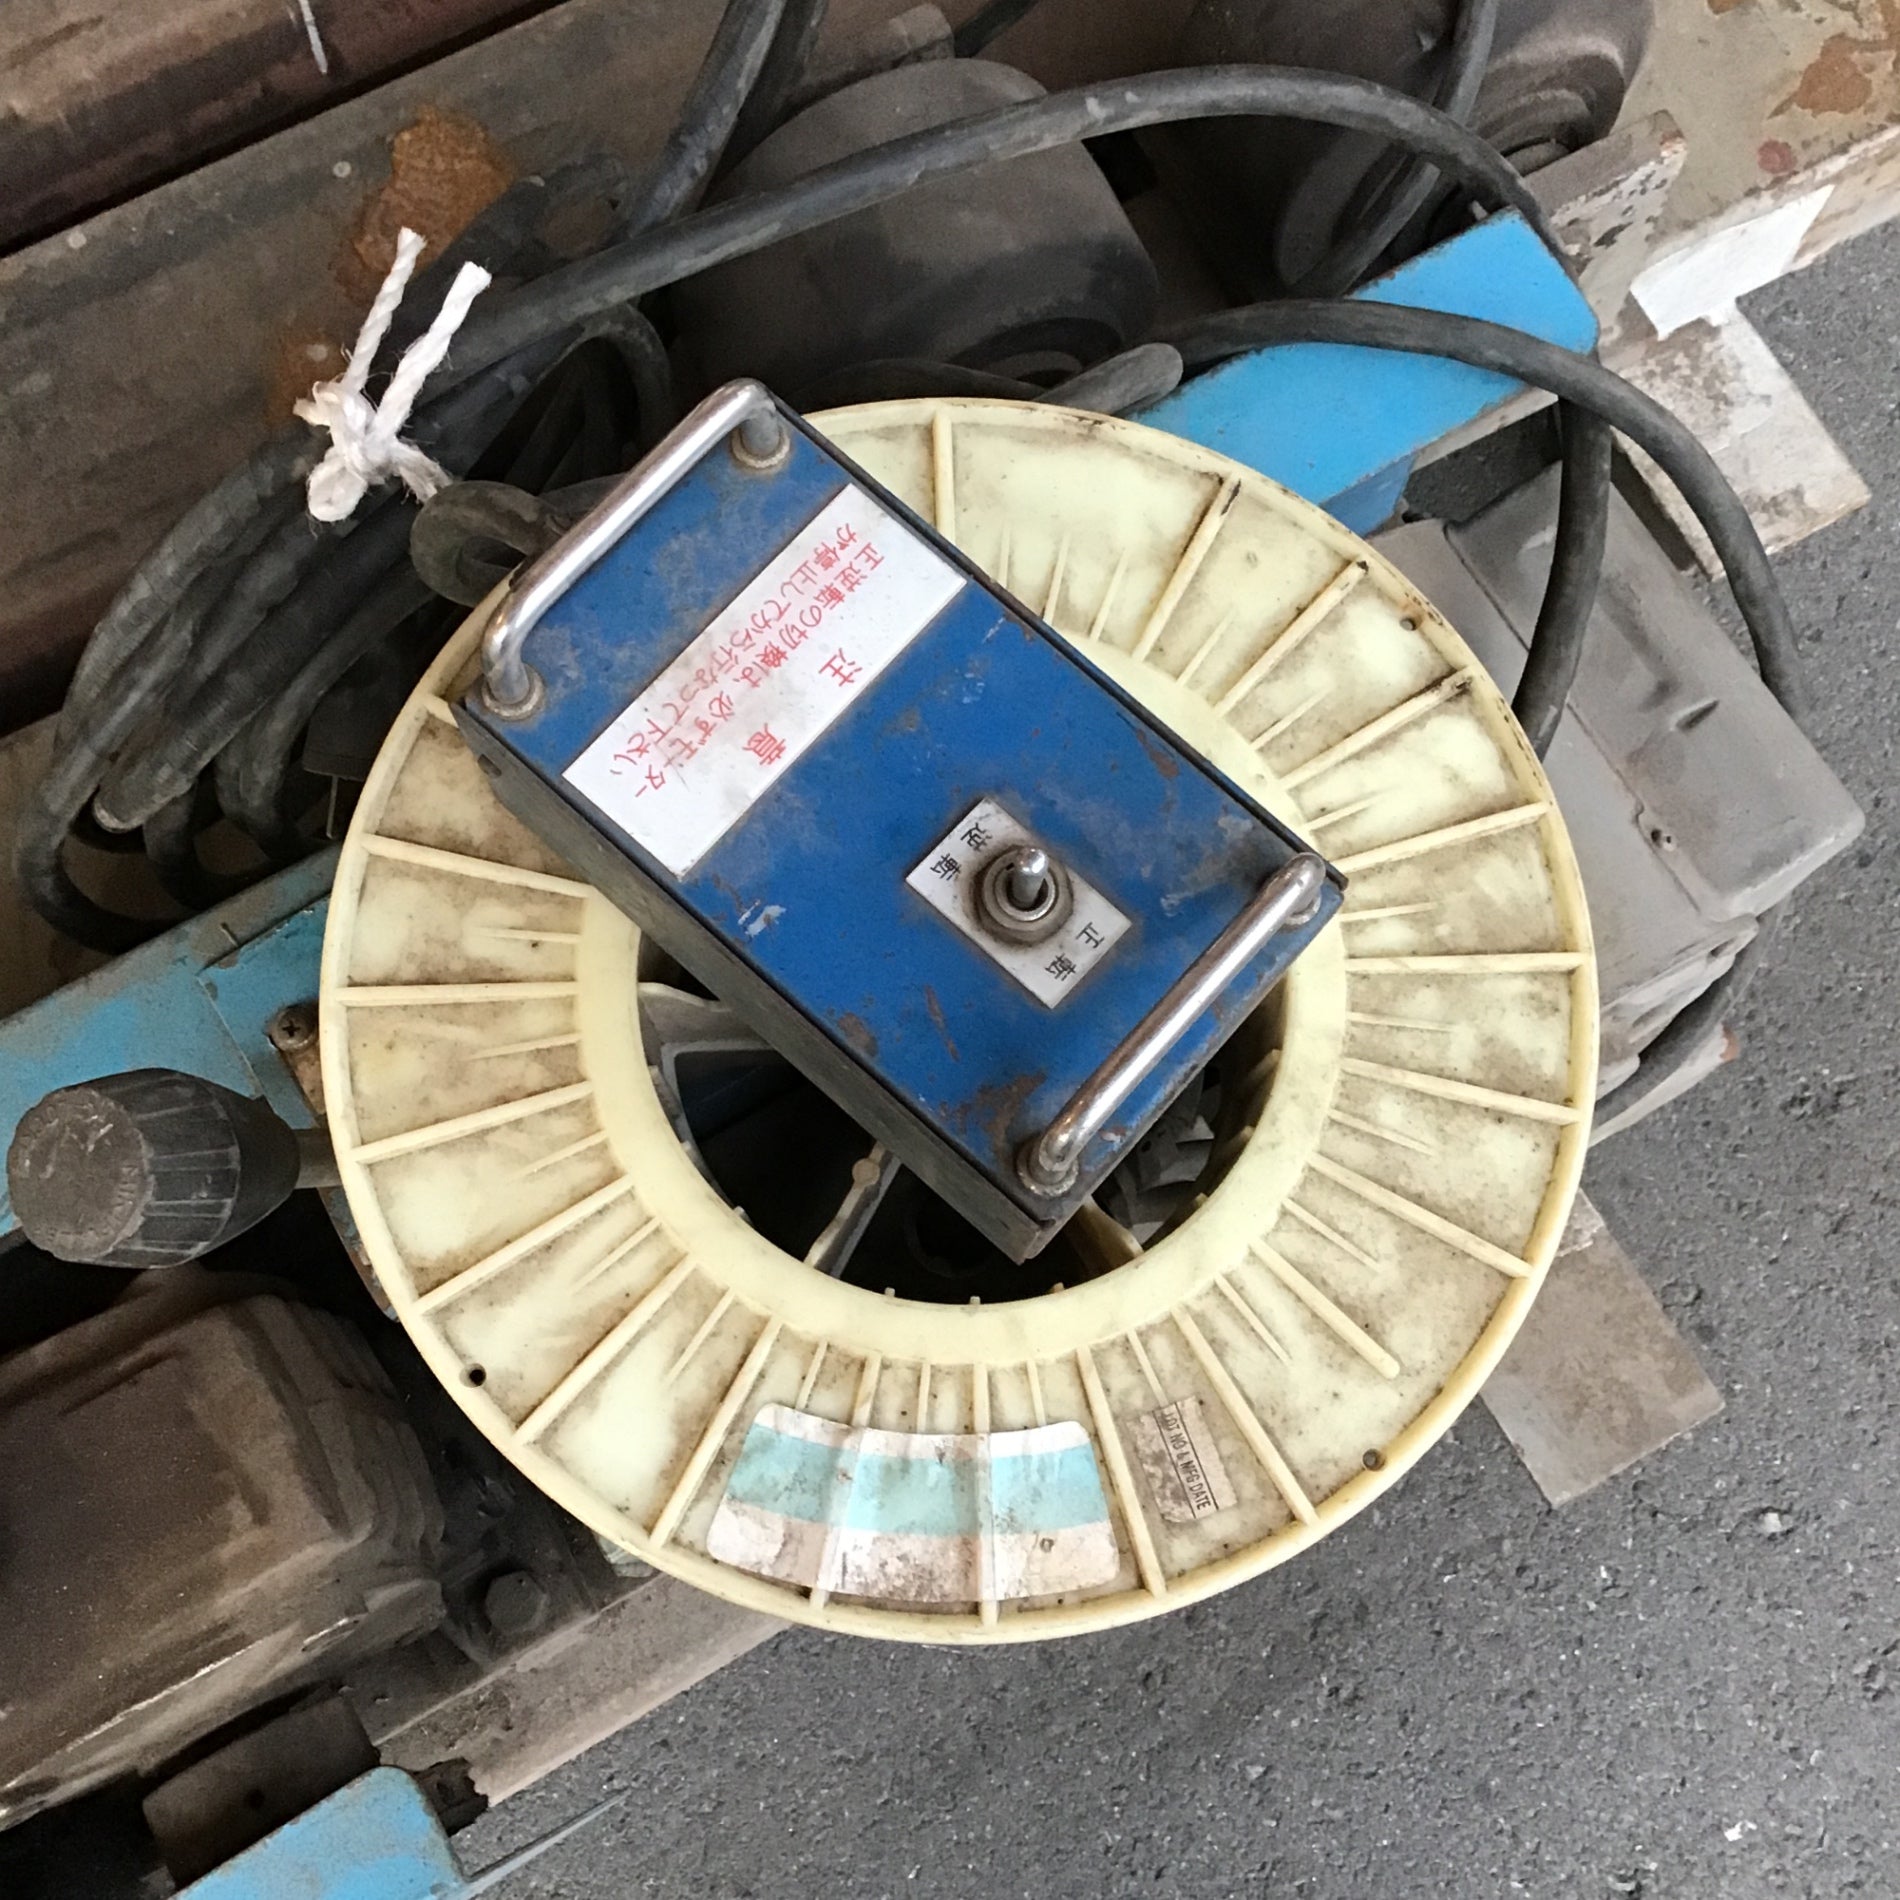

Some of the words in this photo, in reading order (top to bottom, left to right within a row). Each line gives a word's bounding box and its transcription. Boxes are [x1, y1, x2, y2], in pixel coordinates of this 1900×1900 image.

[930, 822, 993, 881] 逆転
[1045, 921, 1105, 981] 正転
[1163, 1412, 1181, 1431] LOT
[1180, 1460, 1200, 1483] MFG
[1189, 1482, 1211, 1510] DATE
